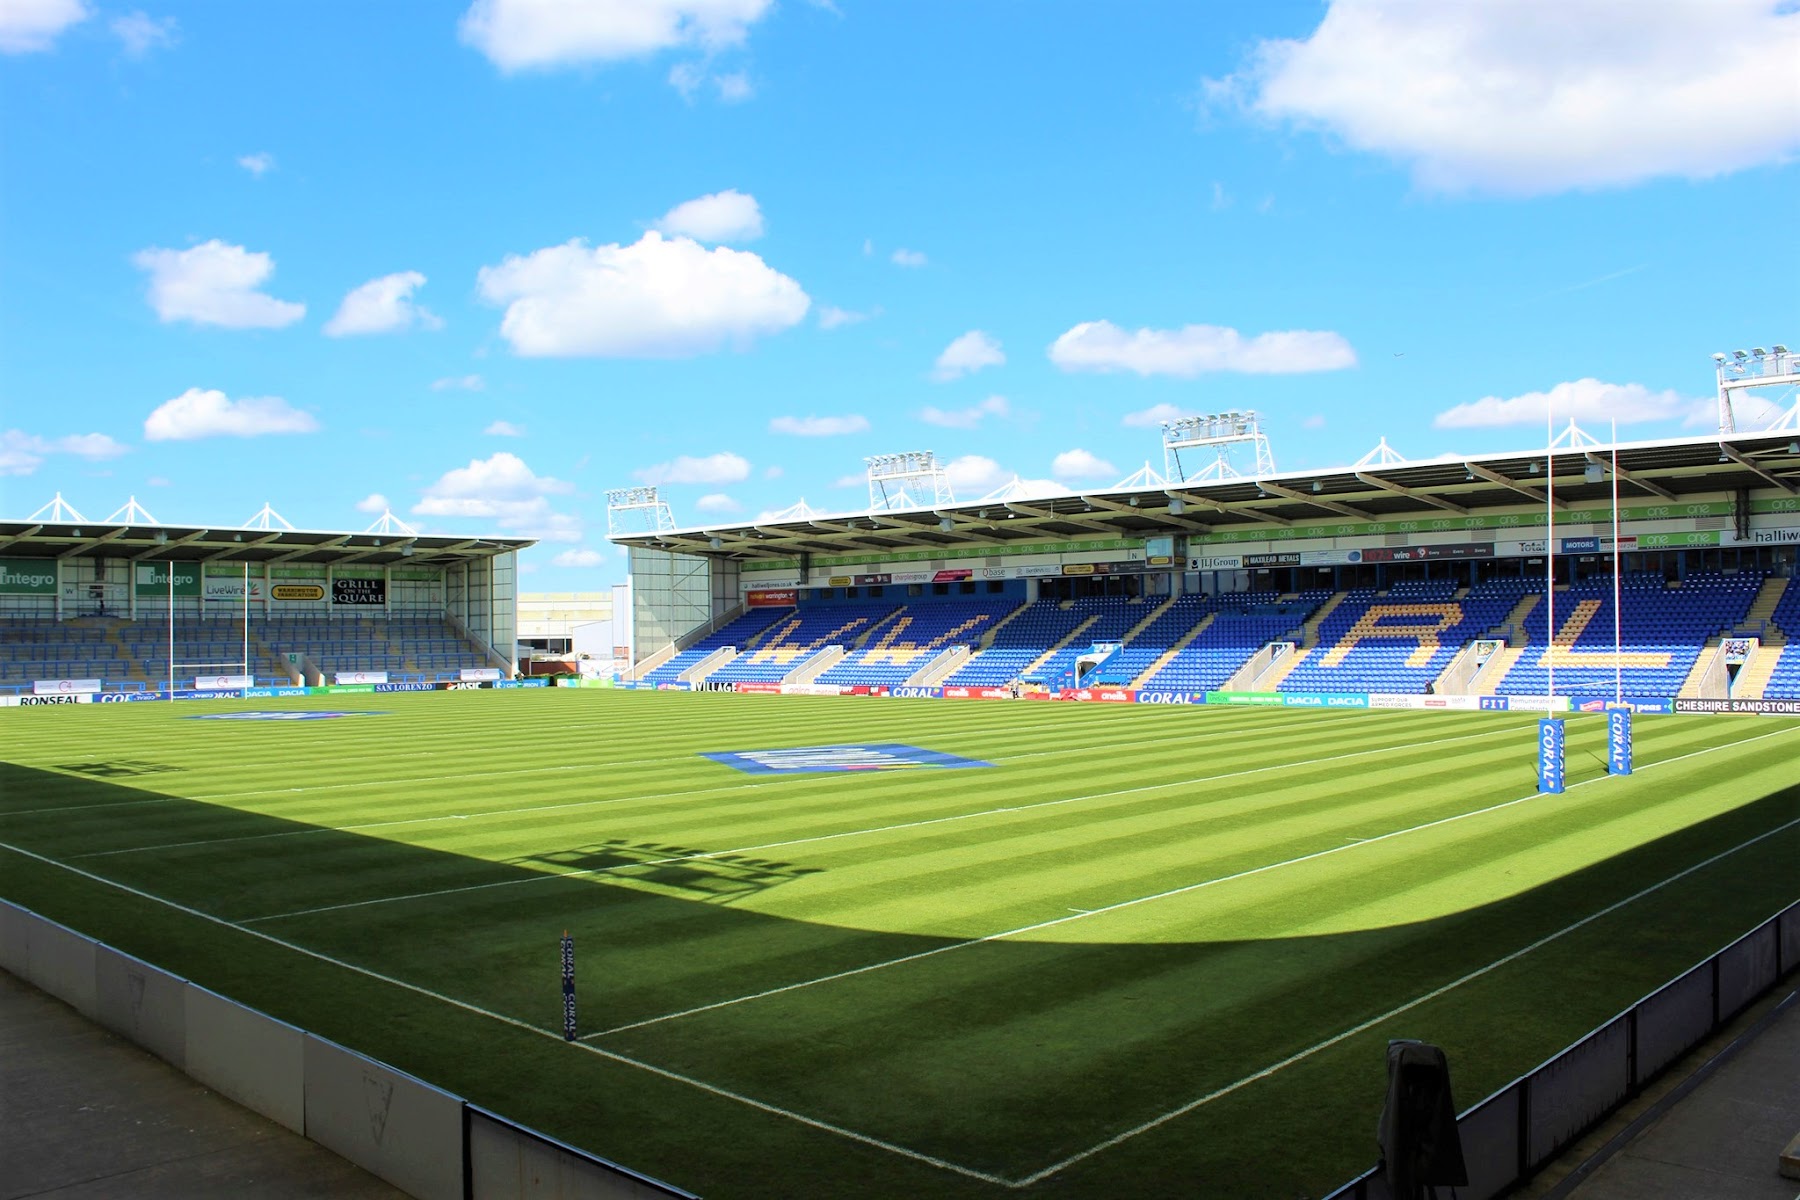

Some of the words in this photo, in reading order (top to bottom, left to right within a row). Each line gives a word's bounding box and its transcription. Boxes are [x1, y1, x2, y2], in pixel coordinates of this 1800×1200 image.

[1686, 504, 1710, 514] one
[1772, 499, 1796, 510] one
[1570, 511, 1592, 520] one
[1647, 506, 1669, 516] one
[1432, 520, 1451, 528] one
[1466, 518, 1485, 526] one
[1500, 516, 1519, 524] one
[1338, 525, 1355, 534] one
[1368, 523, 1386, 532] one
[1400, 522, 1418, 530] one
[1222, 532, 1238, 540] one
[1250, 530, 1266, 539] one
[1278, 528, 1295, 537] one
[1308, 527, 1325, 536] one
[1756, 530, 1800, 542] halliw
[1646, 536, 1668, 544] one
[1687, 534, 1710, 542] one
[1518, 541, 1546, 552] Total
[1201, 559, 1212, 568] JLJ
[1214, 558, 1238, 567] Group
[2, 572, 54, 587] integro
[337, 580, 378, 588] GRILL
[206, 585, 246, 594] LiveWire
[332, 594, 384, 604] SQUARE
[696, 682, 737, 692] VILLAGE
[893, 687, 934, 698] CORAL
[20, 695, 80, 706] RONSEAL
[1140, 692, 1193, 704] CORAL
[1286, 697, 1322, 705] DACIA
[1328, 698, 1364, 706] DACIA
[1482, 700, 1506, 708] FIT
[1637, 704, 1662, 713] peas
[1676, 701, 1730, 711] CHESHIRE
[1732, 702, 1800, 712] SANDSTONE
[1612, 712, 1624, 762] CORAL
[1542, 724, 1555, 780] CORAL
[566, 940, 574, 978] CORAL
[568, 993, 577, 1032] CORAL
